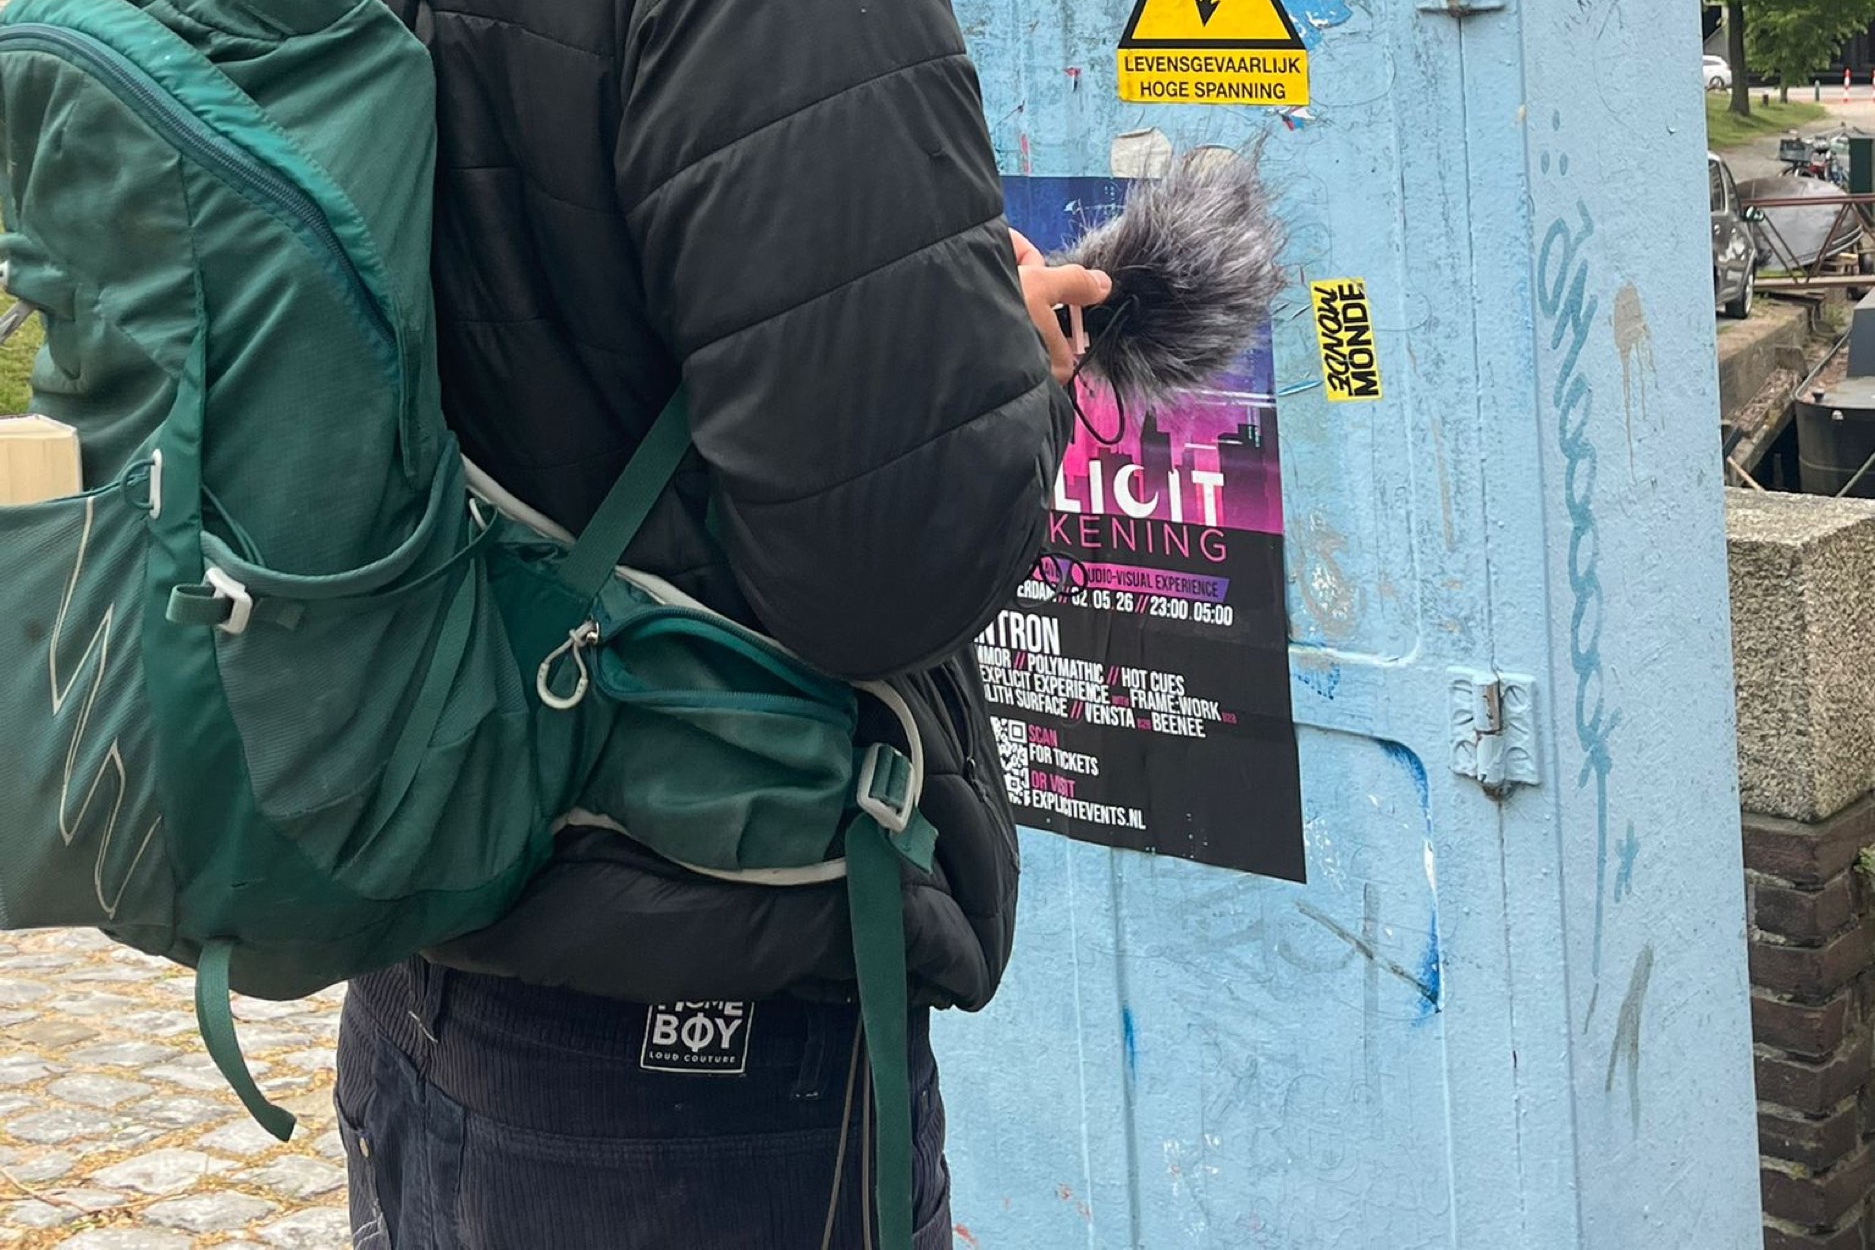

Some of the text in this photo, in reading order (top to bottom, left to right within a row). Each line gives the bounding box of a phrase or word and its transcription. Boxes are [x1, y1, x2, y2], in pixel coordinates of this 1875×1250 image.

[1125, 56, 1300, 74] LEVENSGEVAARLIJK
[1140, 81, 1286, 99] HOGE SPANNING
[1338, 283, 1379, 397] MONDE
[1155, 575, 1218, 598] EXPERIENCE
[979, 665, 1031, 692] EXPLICIT
[1034, 673, 1110, 704] EXPERIENCE
[1027, 653, 1104, 684] POLYMATHIC
[1122, 667, 1147, 690] HOT
[1150, 671, 1184, 696] CUES
[1016, 688, 1068, 718] SURFACE
[1085, 702, 1135, 729] VENSTA
[1152, 712, 1206, 738] BEENEE
[1028, 724, 1057, 747] SCAN
[1029, 744, 1099, 776] FOR TICKETS
[1031, 770, 1075, 798] OR VISIT
[1032, 790, 1146, 830] EXPLICITEVENTS.NL
[649, 1051, 736, 1063] LOUD COUTURE
